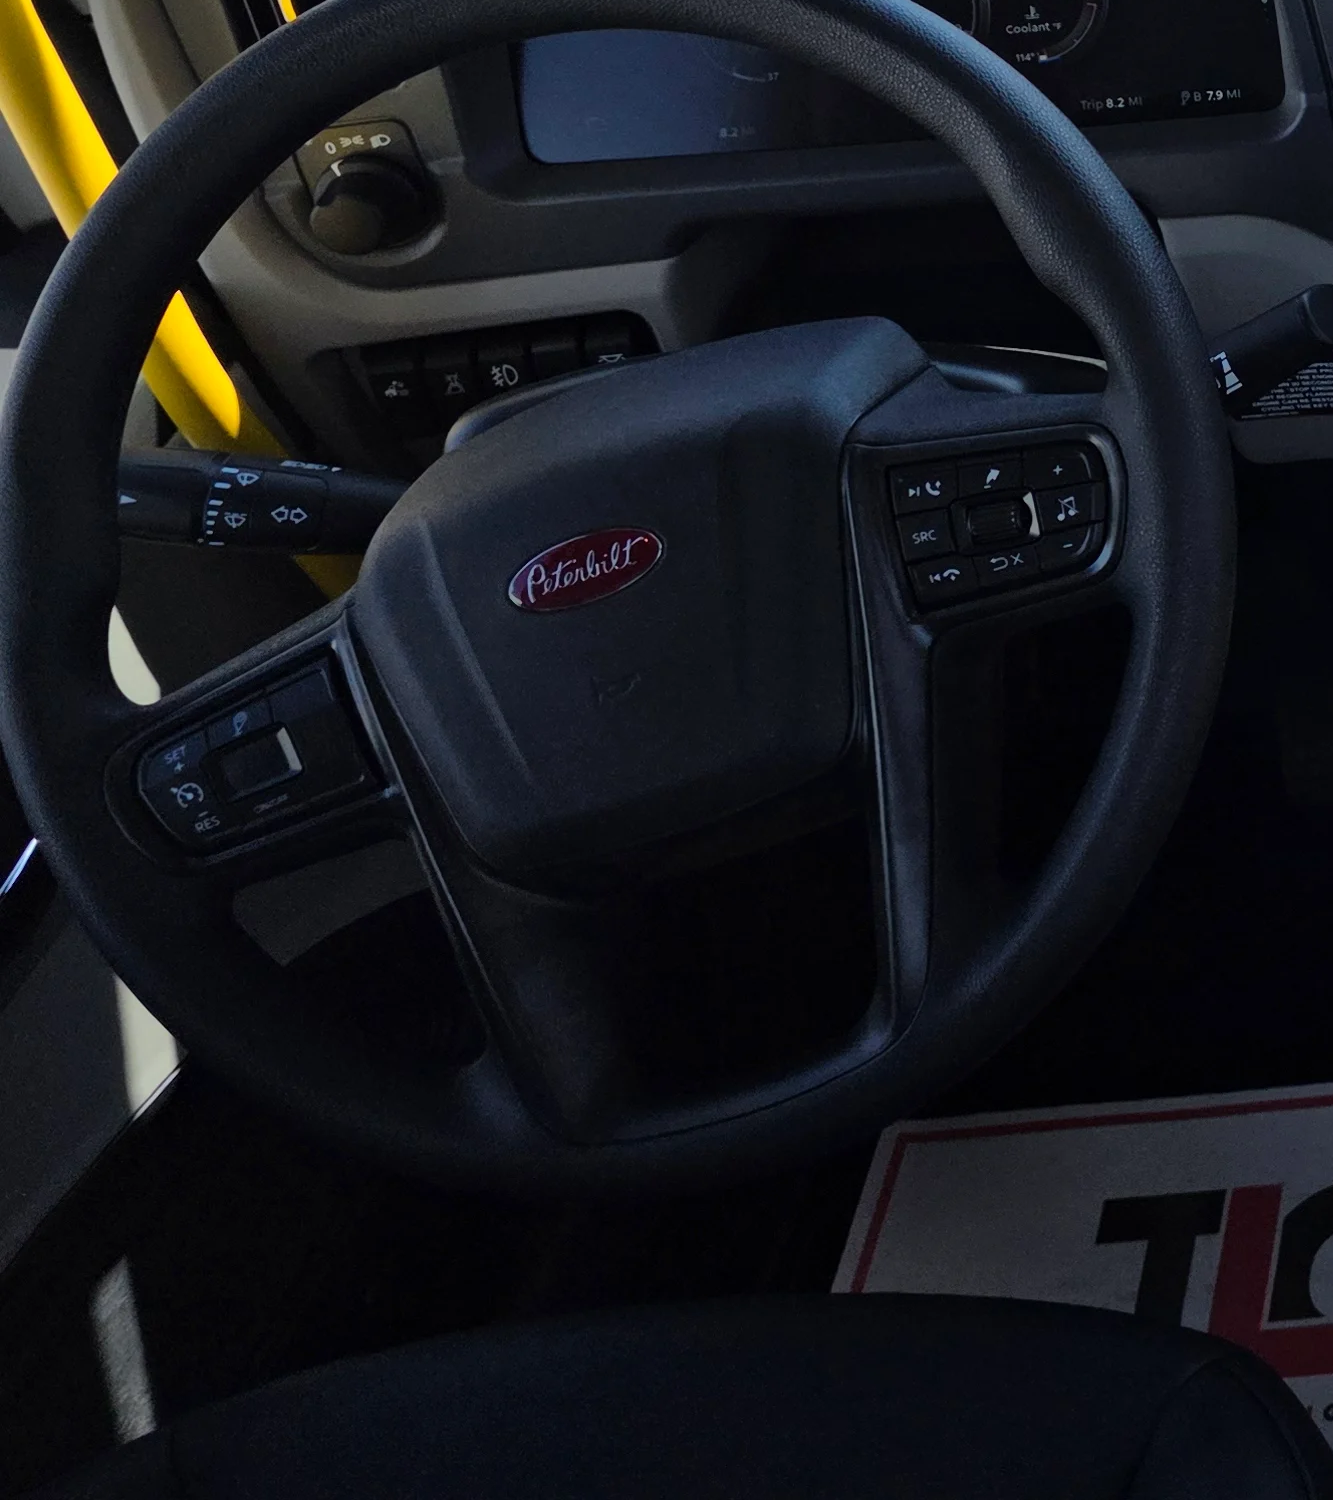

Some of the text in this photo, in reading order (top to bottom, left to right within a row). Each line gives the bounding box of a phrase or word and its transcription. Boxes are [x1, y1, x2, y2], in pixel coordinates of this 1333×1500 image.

[1005, 22, 1051, 34] Coolant
[1193, 88, 1241, 102] B 7.9 MI
[1080, 100, 1103, 112] Trip
[1105, 98, 1125, 108] 8.2
[912, 529, 937, 545] SRC
[527, 536, 648, 603] Peterbilt
[164, 745, 187, 763] SET
[194, 815, 221, 834] RES
